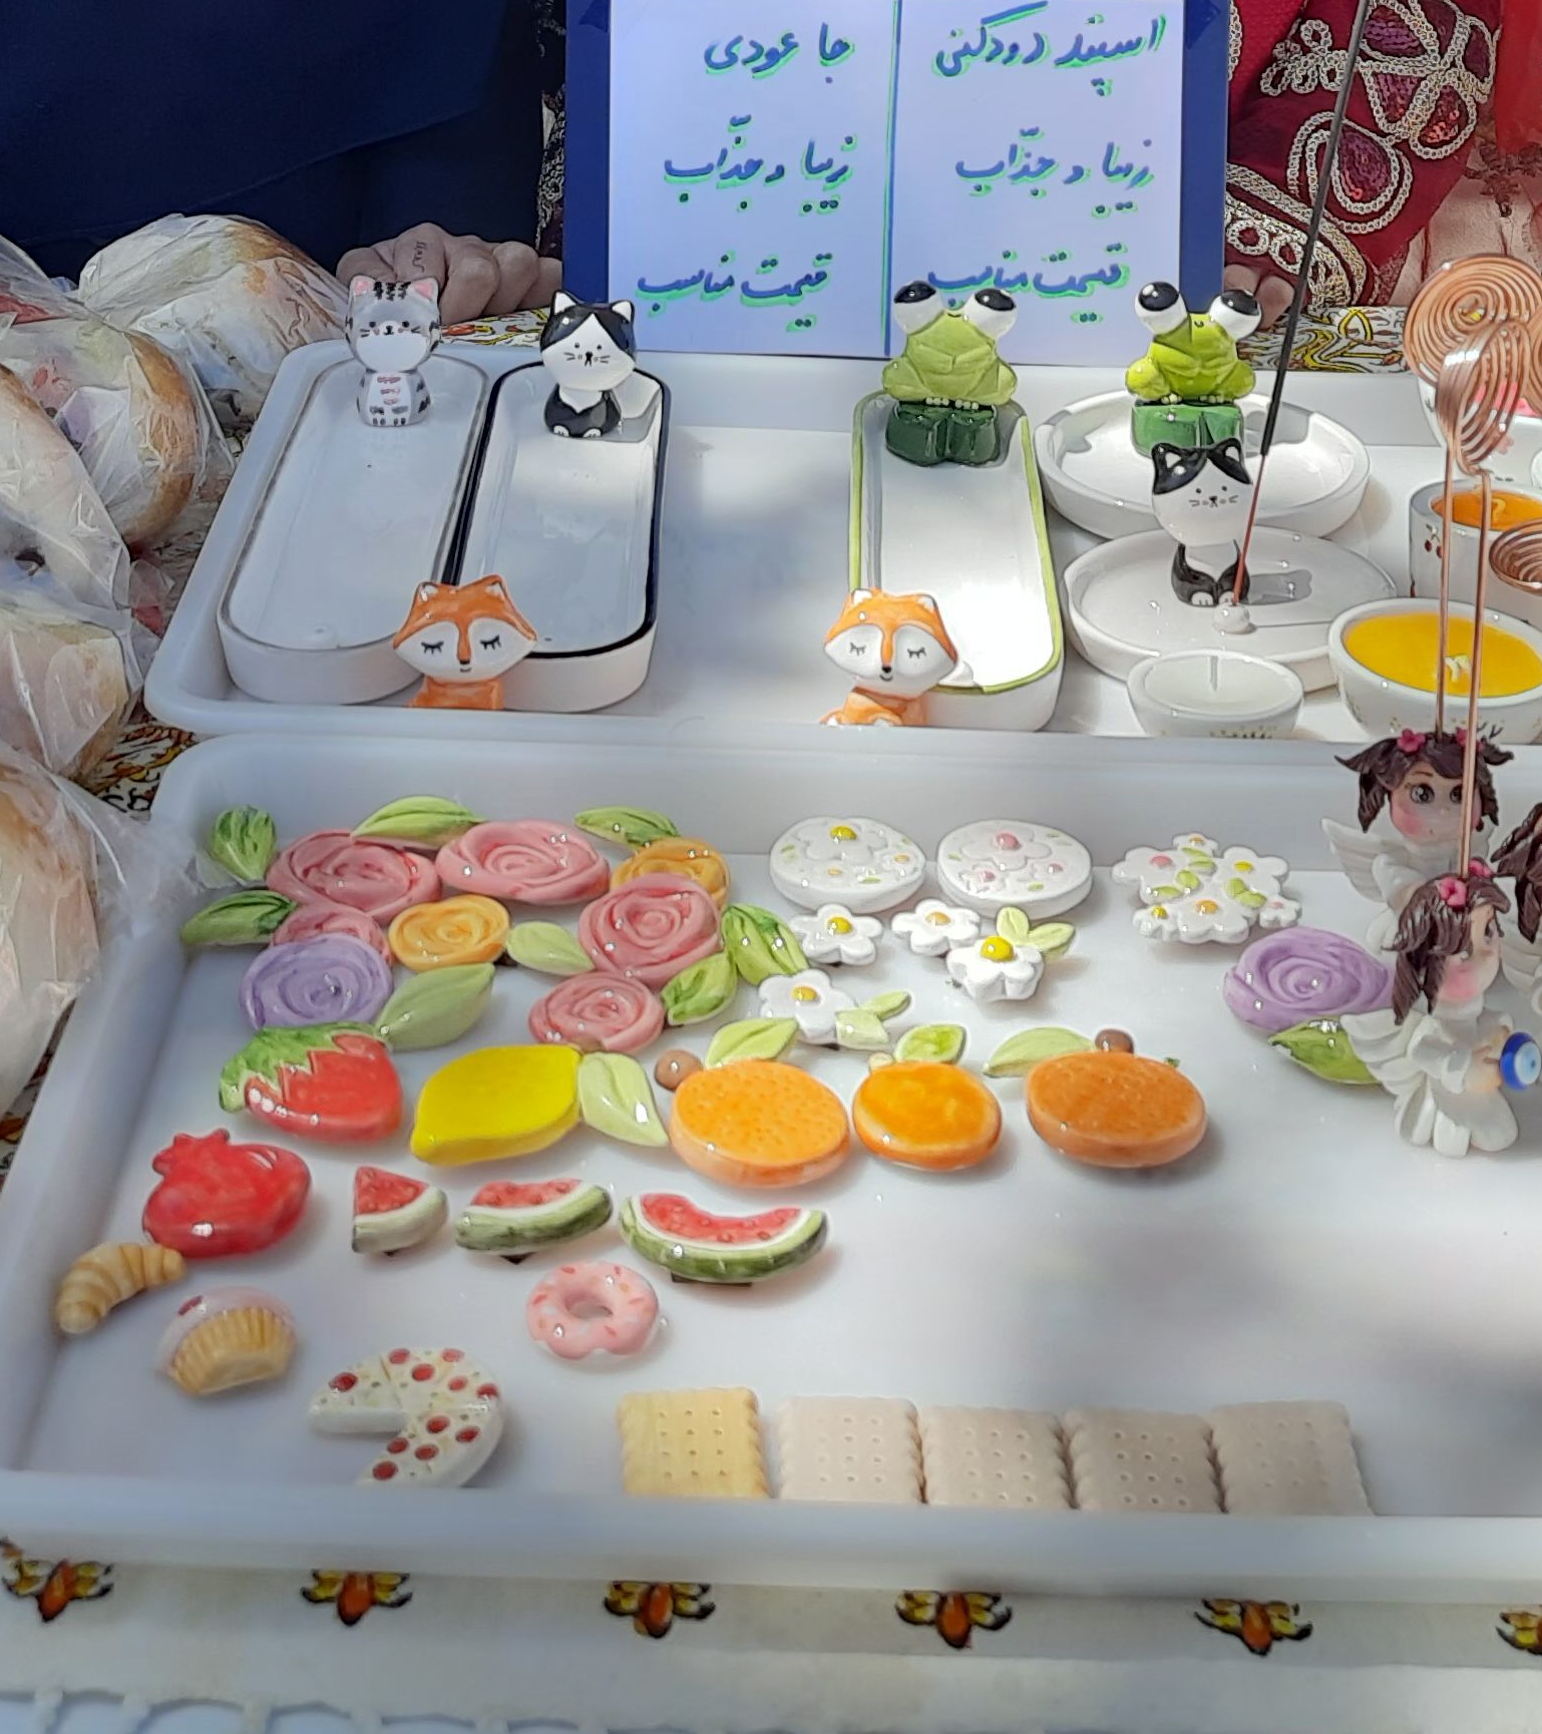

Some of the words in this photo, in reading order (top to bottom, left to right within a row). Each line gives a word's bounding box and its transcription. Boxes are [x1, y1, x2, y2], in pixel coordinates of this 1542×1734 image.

[703, 26, 801, 80] عودی
[800, 133, 857, 215] زیبا
[1090, 137, 1160, 217] زیبا
[634, 250, 736, 316] مناسب
[740, 252, 835, 333] قیمت
[926, 249, 1034, 312] مناسب
[1032, 241, 1131, 326] قیمت
